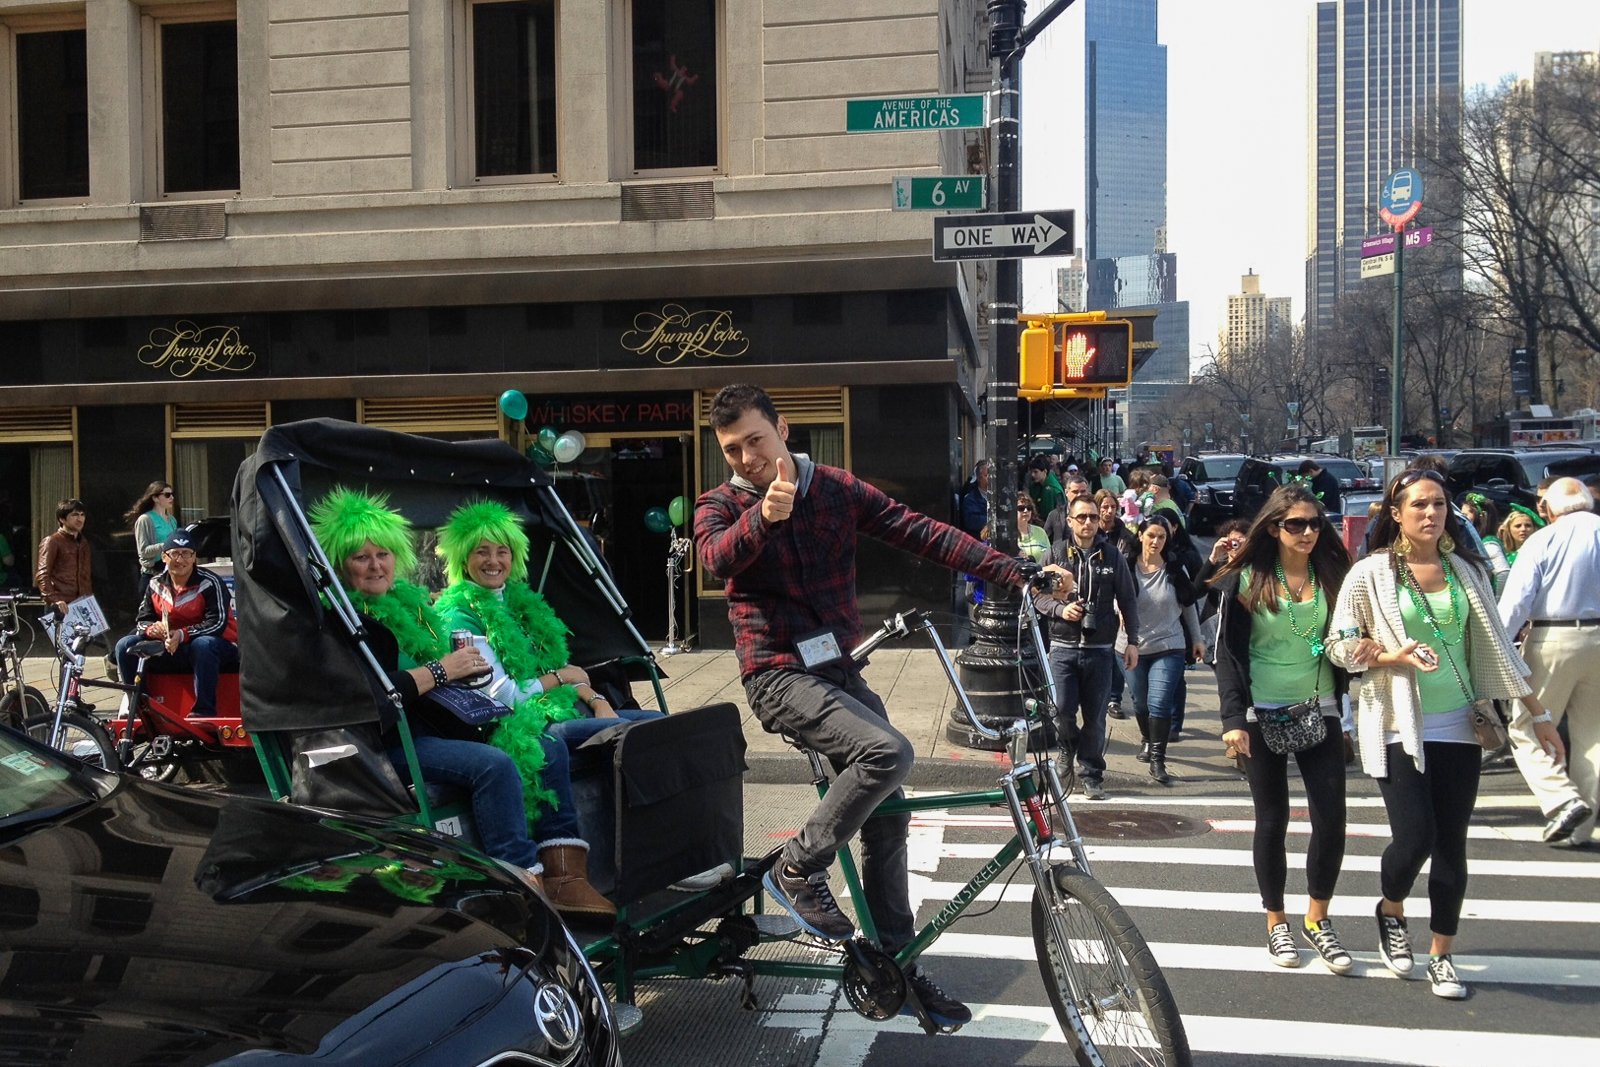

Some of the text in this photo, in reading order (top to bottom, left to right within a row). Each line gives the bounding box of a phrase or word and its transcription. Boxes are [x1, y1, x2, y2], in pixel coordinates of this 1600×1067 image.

[882, 98, 952, 111] AVENUE OF THE
[874, 108, 960, 128] AMERICAS
[932, 180, 971, 205] 6 AV
[954, 225, 1053, 247] ONE WAY
[1405, 231, 1420, 245] M5
[621, 303, 702, 364] Trump
[137, 319, 219, 378] Trump
[531, 403, 694, 425] WHISKEY PARK
[931, 858, 1001, 931] MAIN STREET
